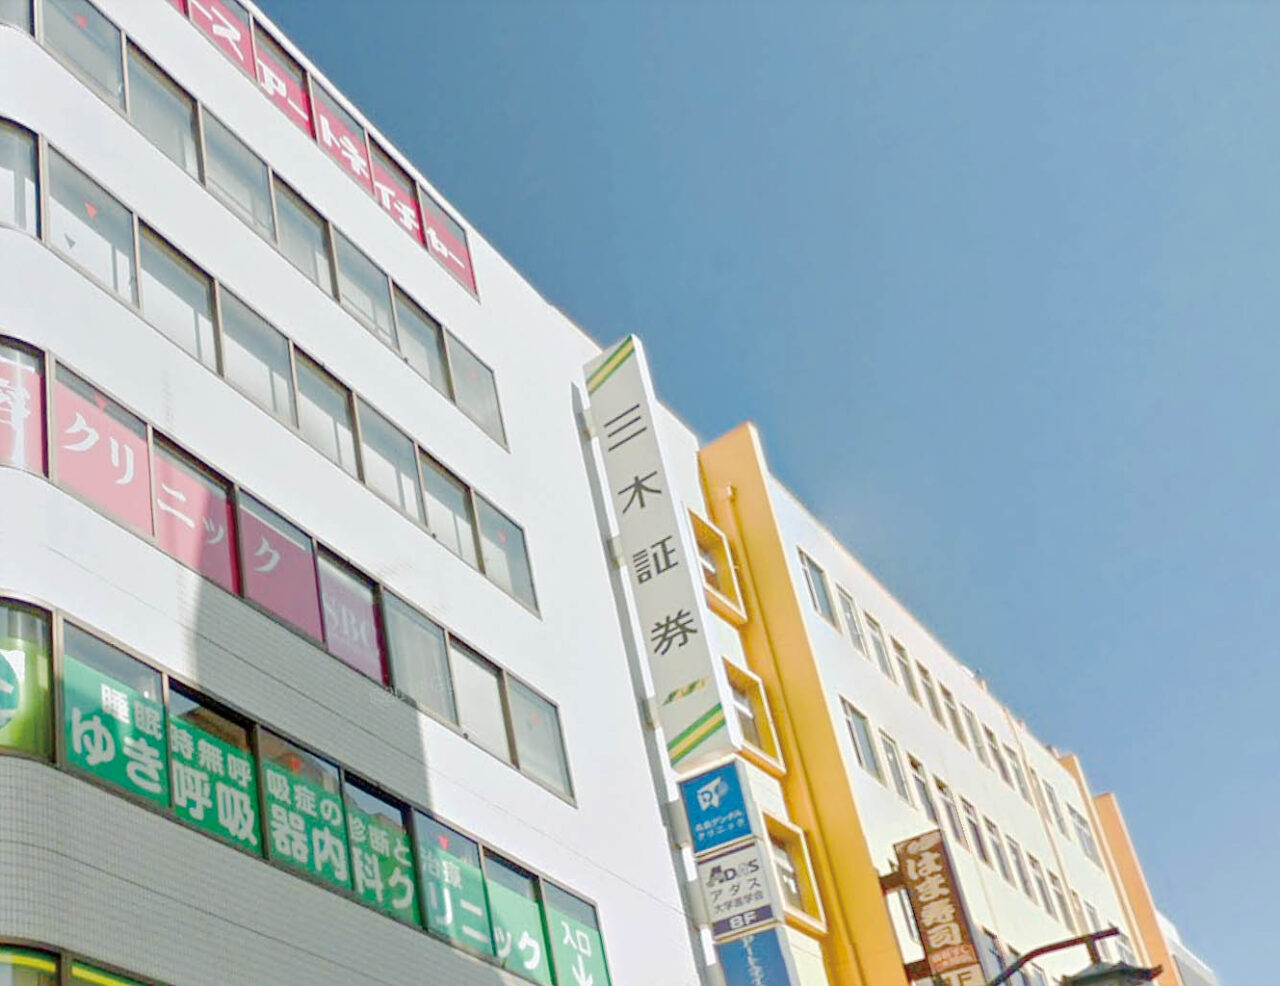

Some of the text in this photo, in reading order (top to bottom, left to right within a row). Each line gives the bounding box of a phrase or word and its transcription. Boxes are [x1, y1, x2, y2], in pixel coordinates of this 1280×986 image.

[604, 403, 698, 656] 三木証券
[72, 706, 541, 969] ゆき呼吸器内科クリニック
[562, 919, 592, 956] 入口
